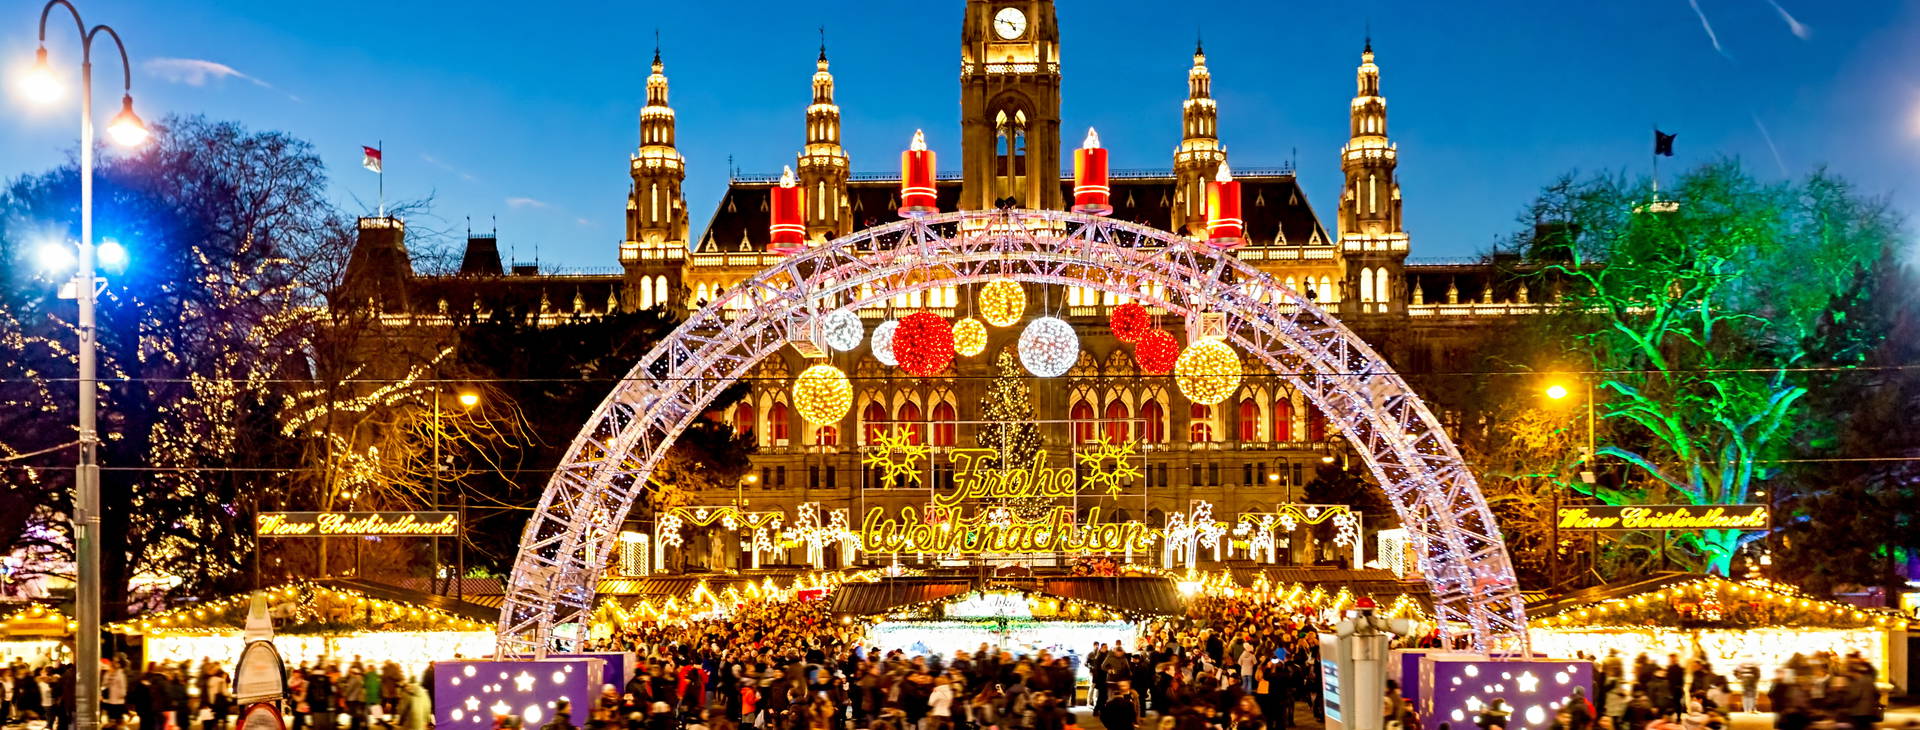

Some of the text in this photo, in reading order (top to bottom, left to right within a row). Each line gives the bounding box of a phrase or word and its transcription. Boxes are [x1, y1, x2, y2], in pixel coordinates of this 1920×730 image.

[933, 448, 1077, 506] Frohe
[257, 513, 458, 534] Wiener Christkindlmarkt
[861, 506, 1149, 553] Weihnachten
[1557, 507, 1768, 528] Wiener Christkindlmarkt
